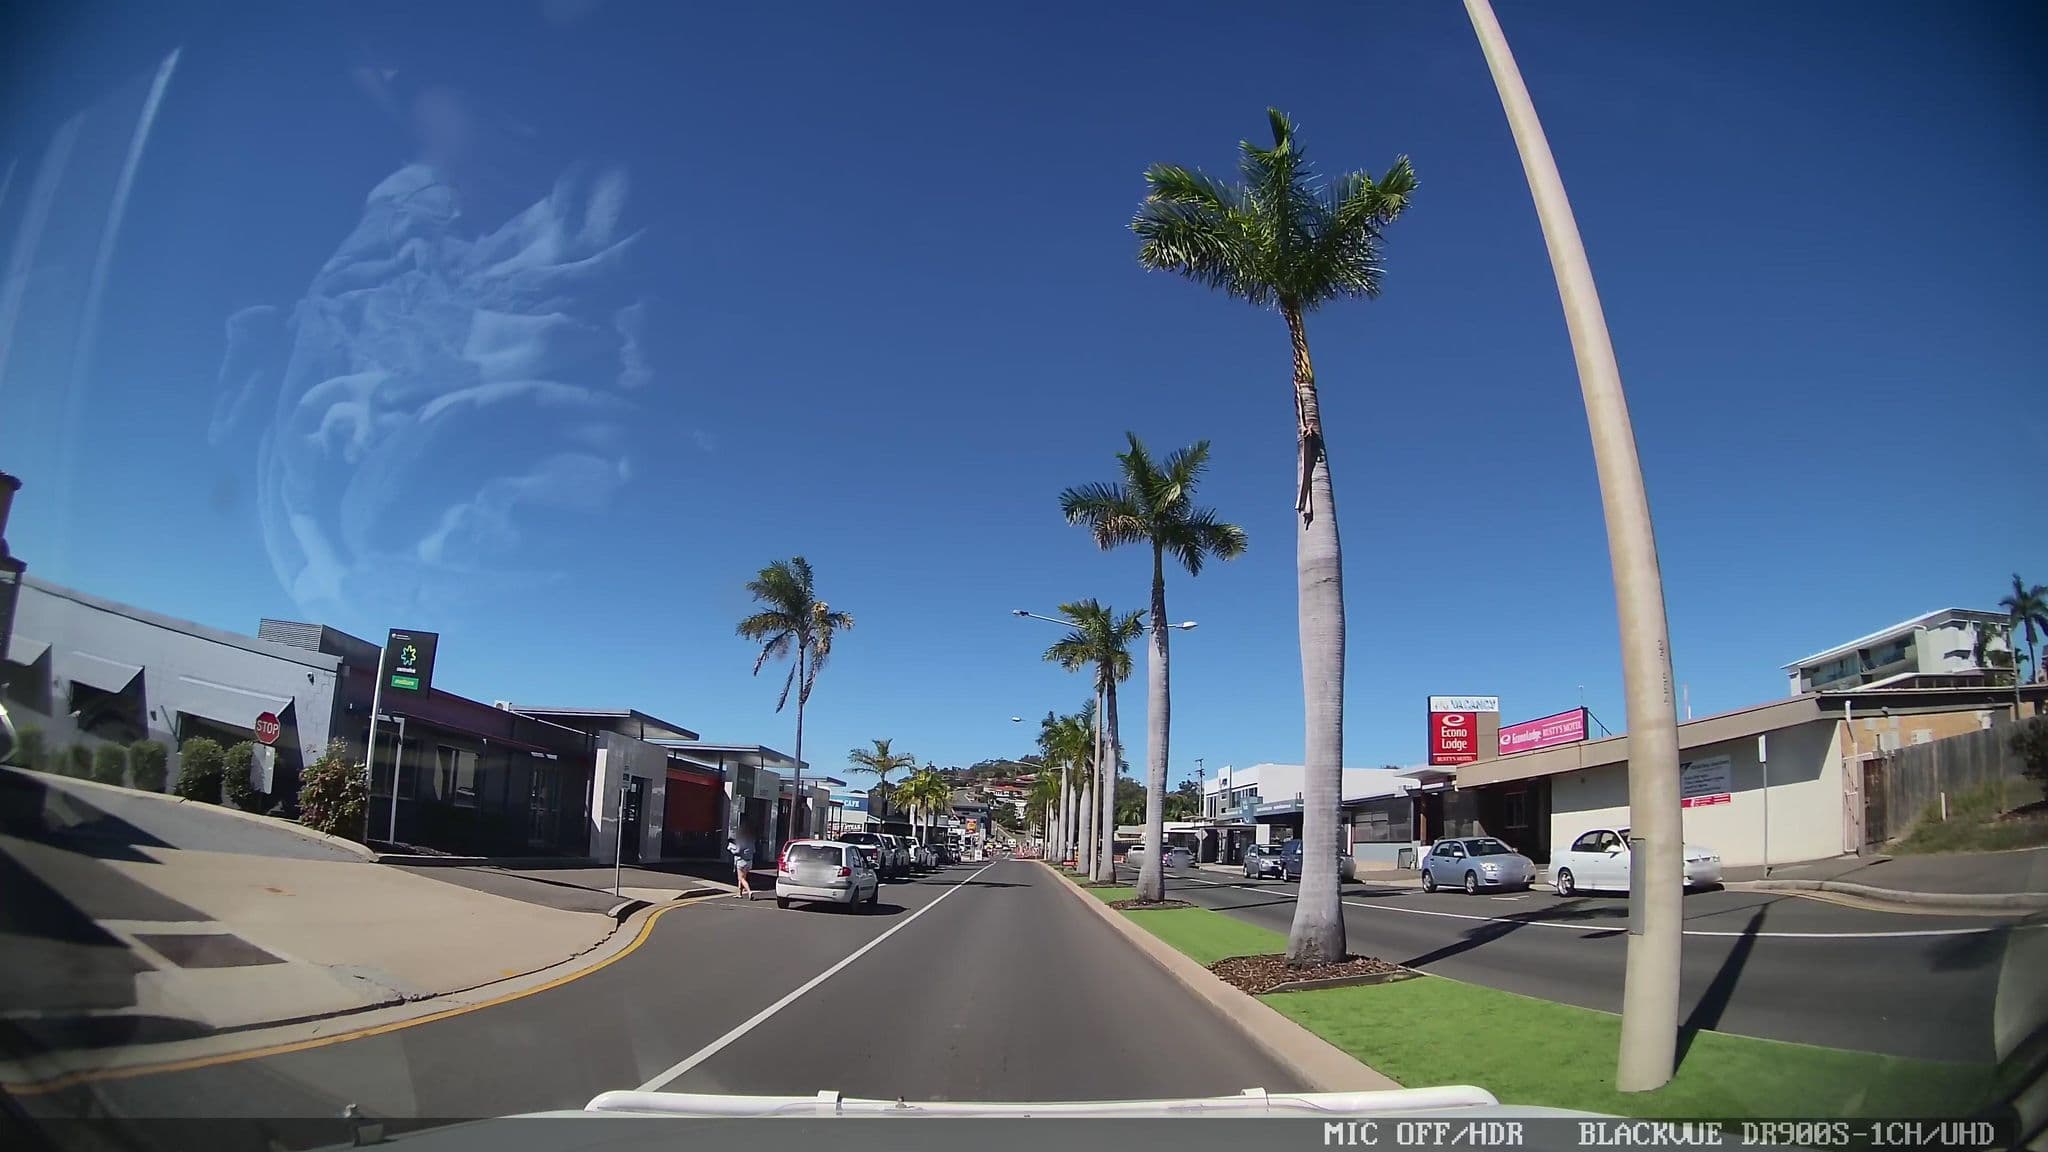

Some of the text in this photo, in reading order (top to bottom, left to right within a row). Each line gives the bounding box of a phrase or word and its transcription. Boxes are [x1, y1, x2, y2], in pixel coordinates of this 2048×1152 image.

[256, 720, 279, 735] STOP
[1441, 726, 1468, 738] Econo
[1441, 738, 1468, 752] Lodge
